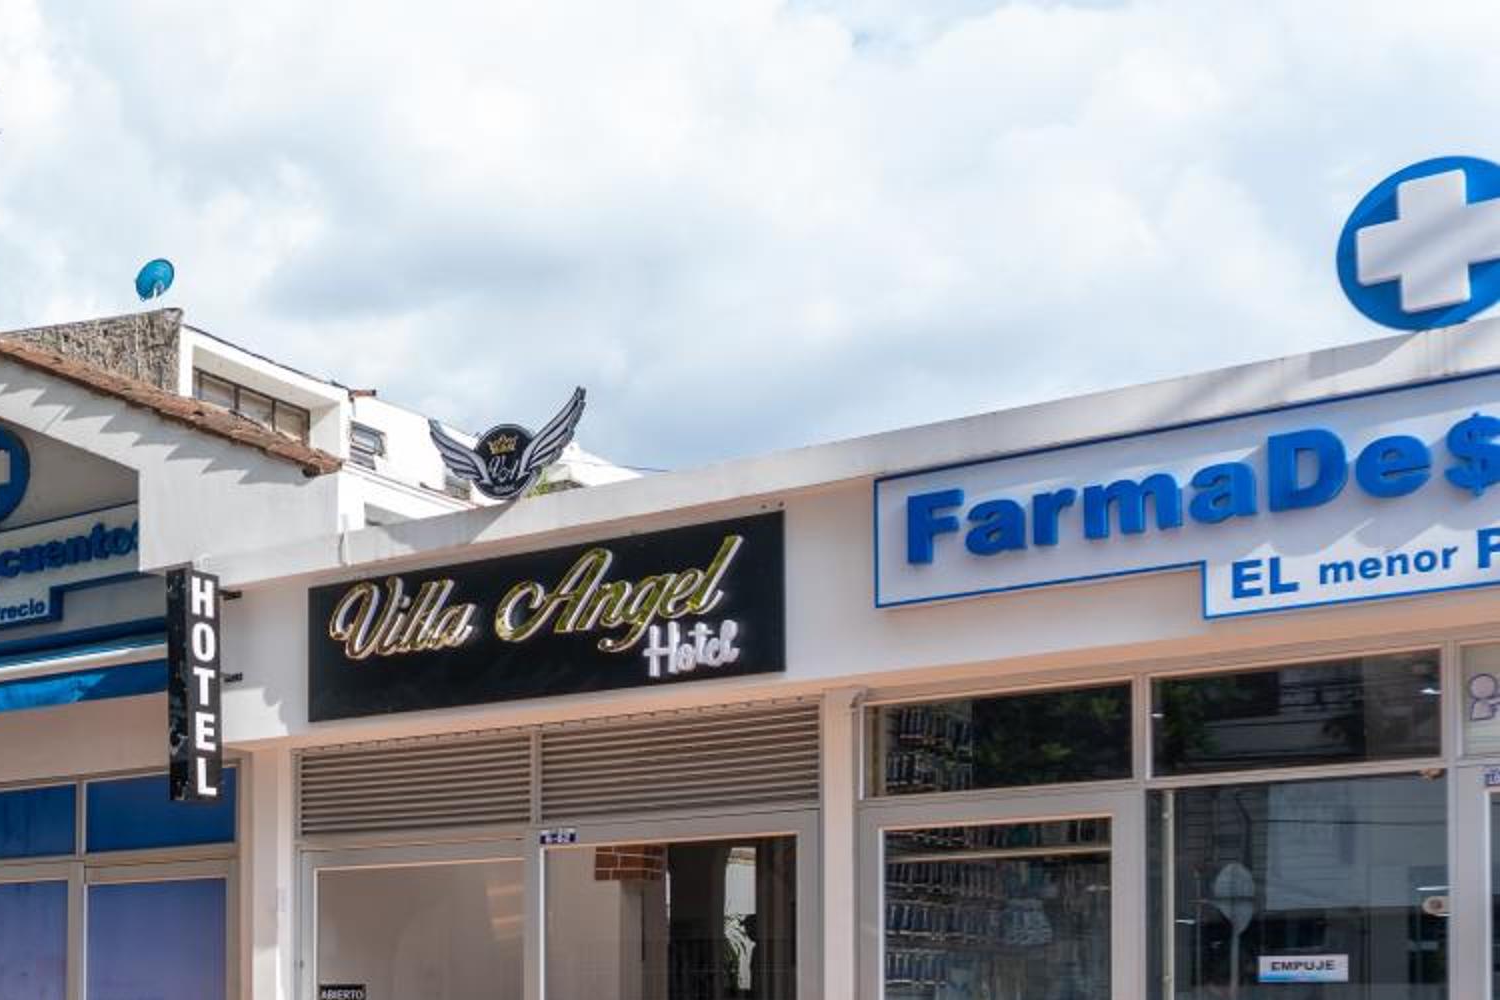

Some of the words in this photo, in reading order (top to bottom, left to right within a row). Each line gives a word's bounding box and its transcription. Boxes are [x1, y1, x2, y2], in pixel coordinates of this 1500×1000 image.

[329, 575, 476, 660] Villa
[495, 535, 743, 652] Angel
[1232, 557, 1299, 599] EL
[1319, 544, 1459, 585] menor
[643, 617, 739, 678] Hotel
[191, 576, 217, 797] HOTEL
[321, 989, 363, 1000] ABIERTO
[1271, 960, 1335, 971] EMPUJE
